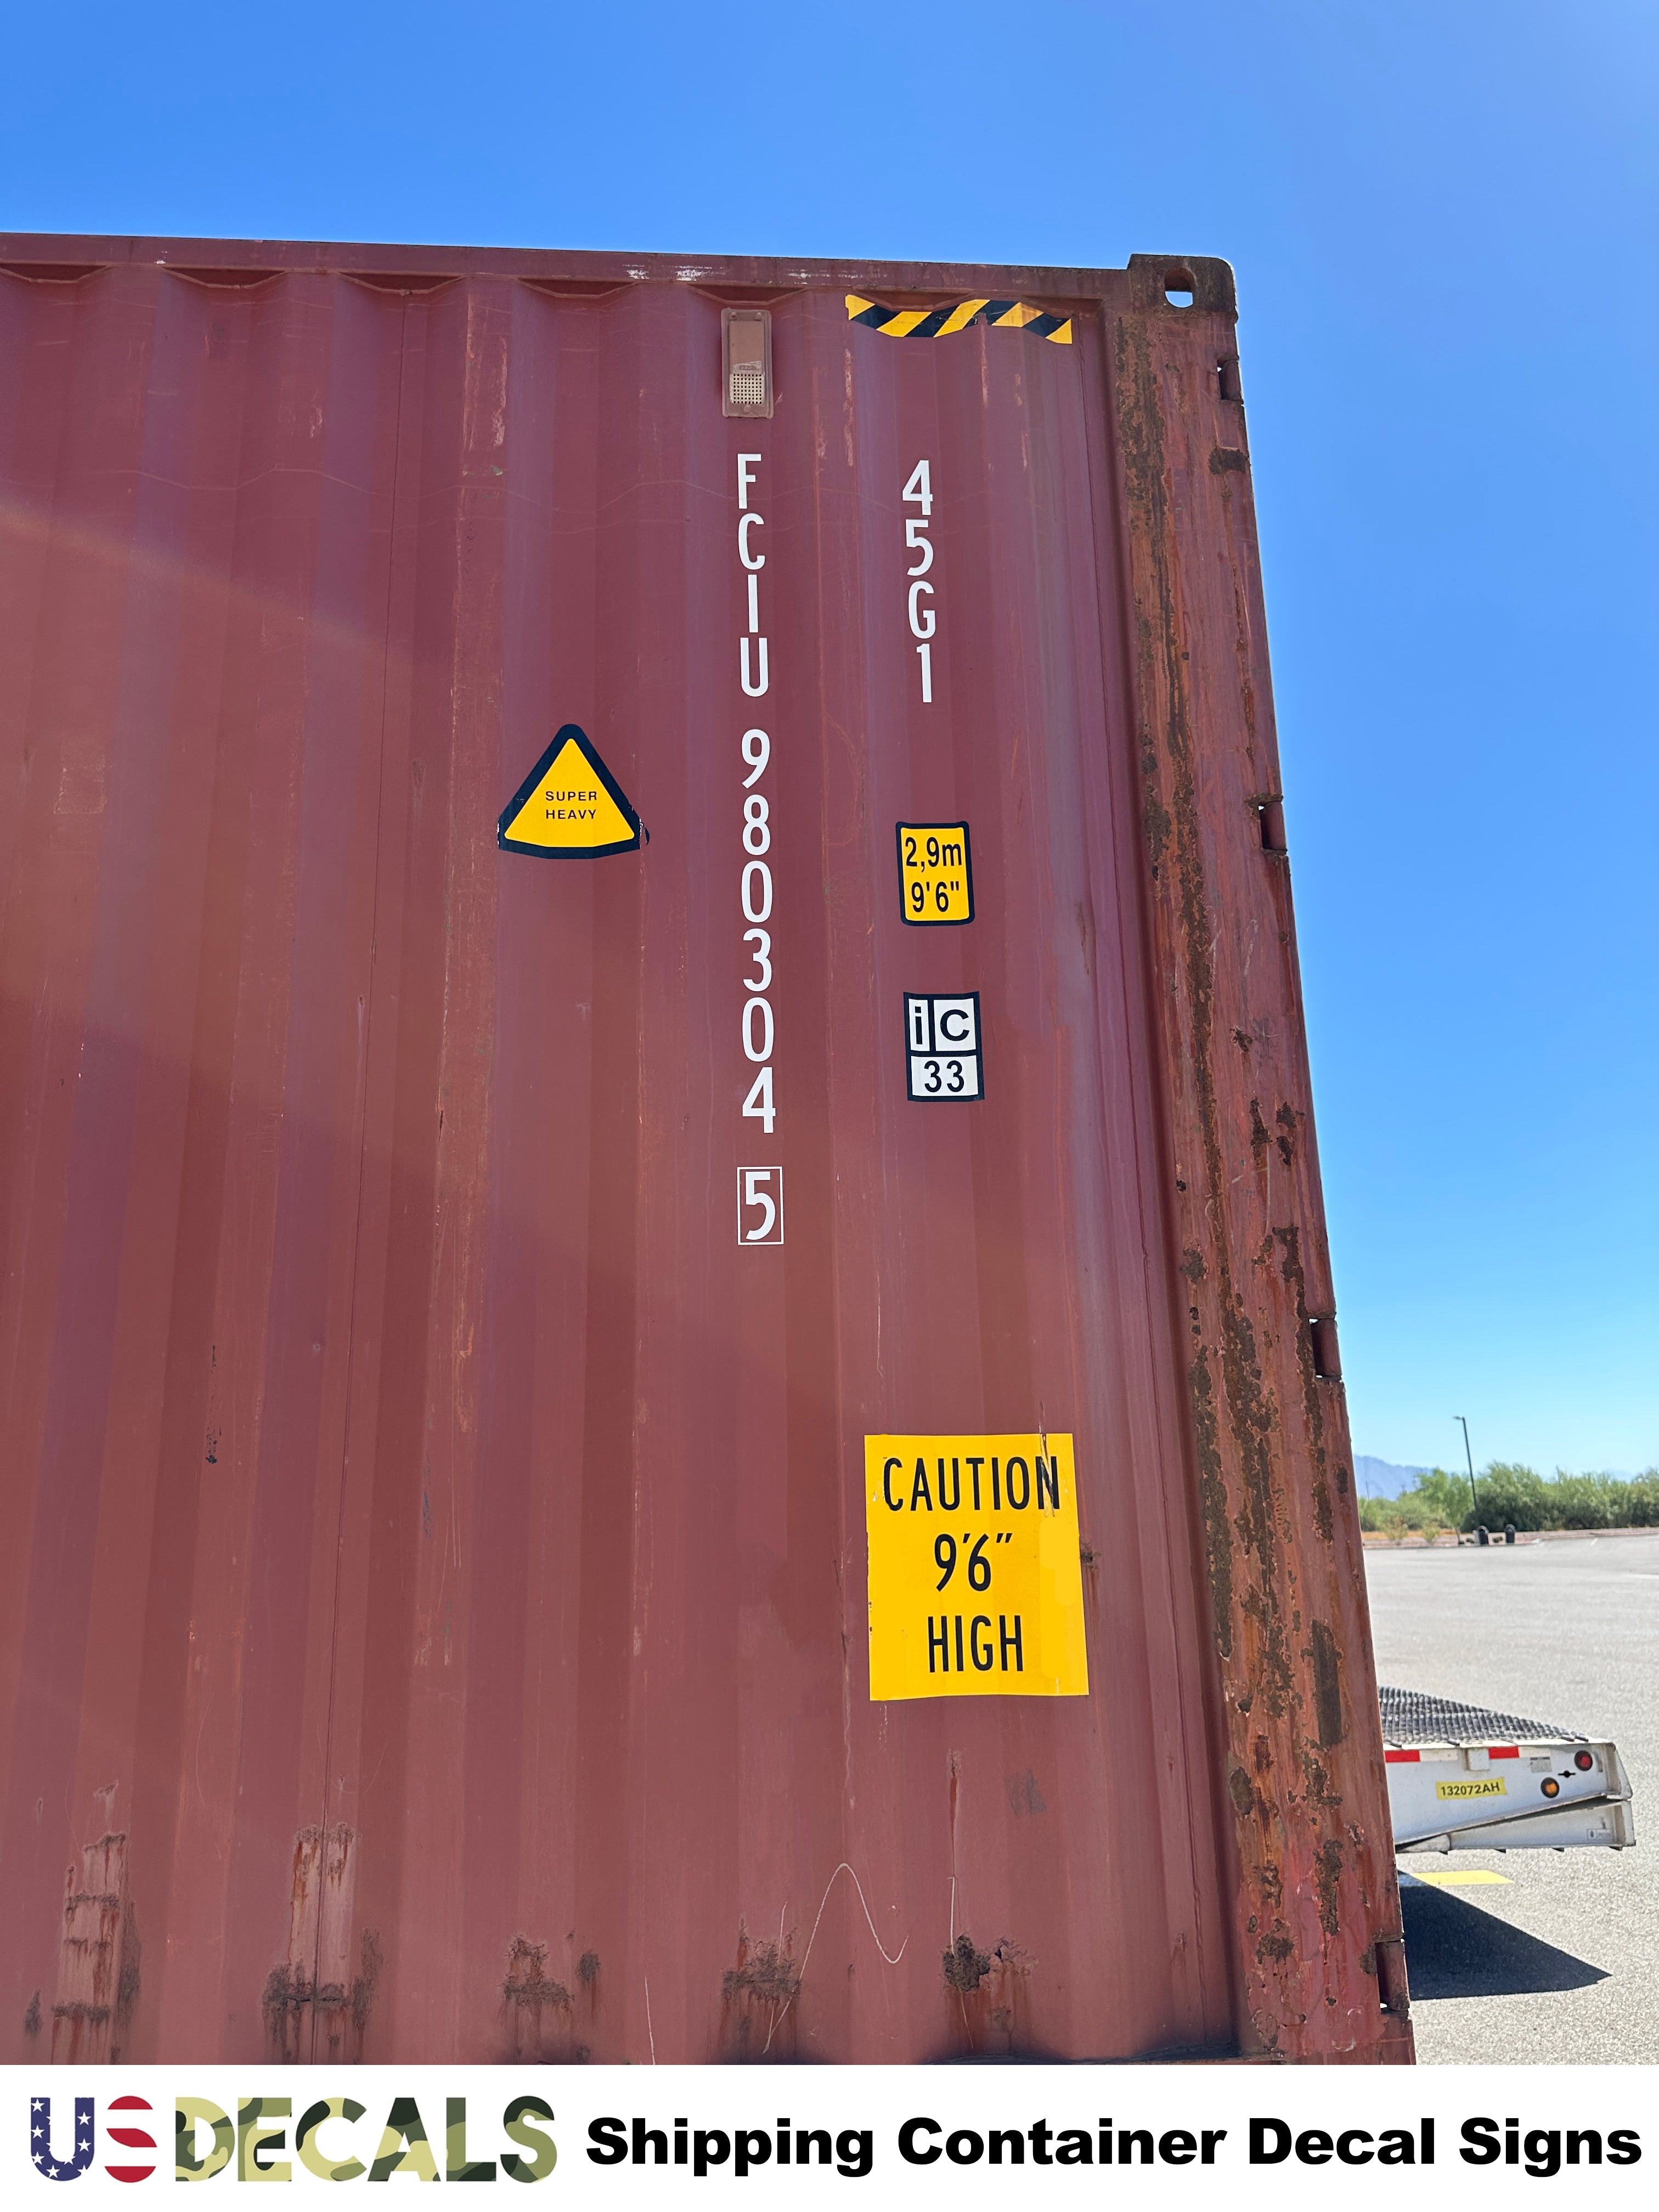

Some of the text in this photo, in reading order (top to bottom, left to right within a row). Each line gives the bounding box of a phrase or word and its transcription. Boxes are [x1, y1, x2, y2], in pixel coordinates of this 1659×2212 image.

[902, 460, 936, 703] 45G1
[545, 791, 597, 801] SUPER
[545, 809, 597, 820] HEAVY
[737, 453, 776, 1240] FCIU 980304 5
[905, 837, 962, 872] 2,9m
[924, 1060, 965, 1093] 33
[883, 1455, 1060, 1511] CAUTION
[928, 1615, 1024, 1673] HIGH
[1441, 1782, 1500, 1796] 132072AH
